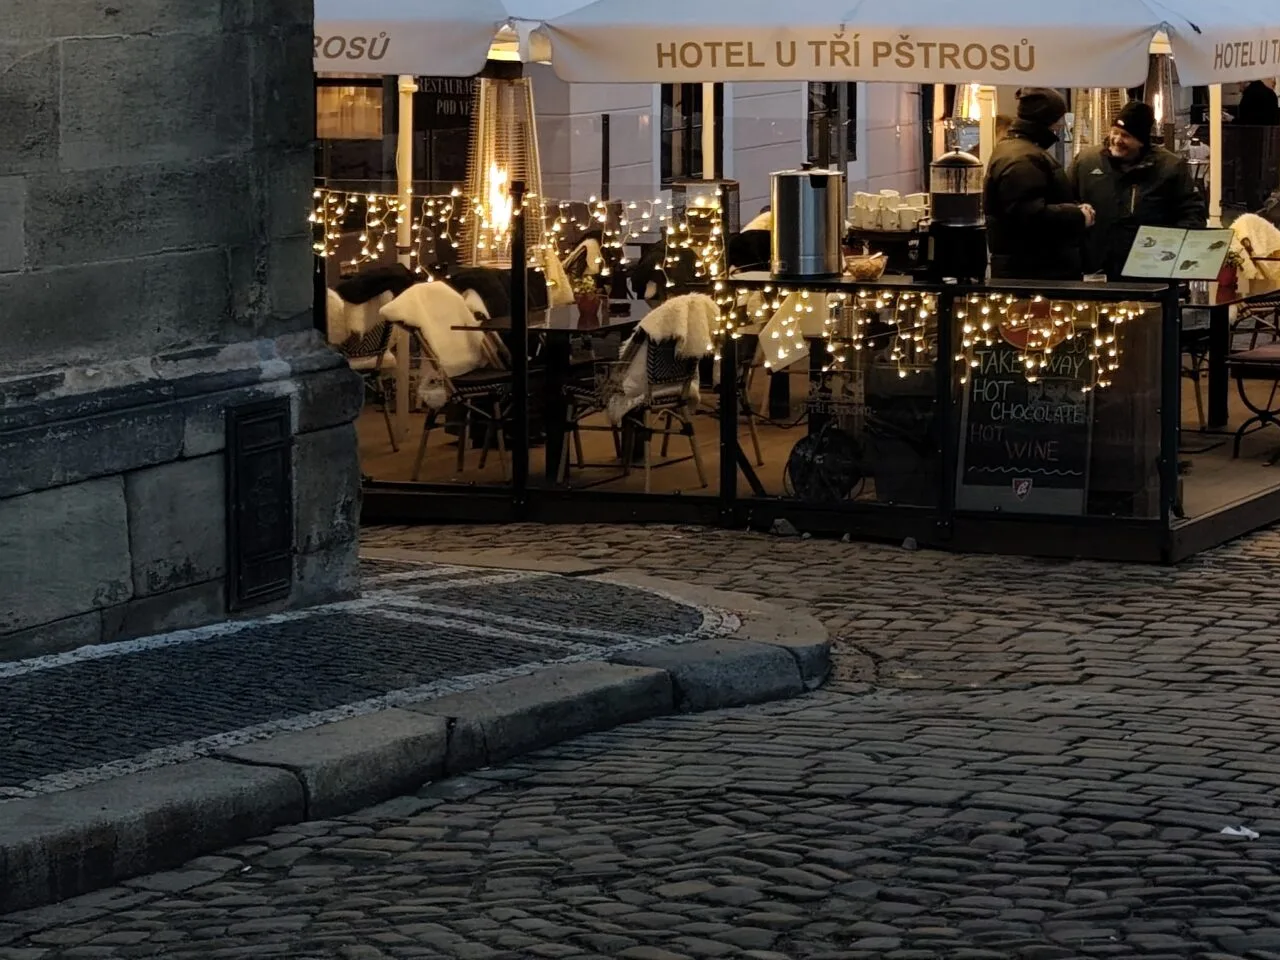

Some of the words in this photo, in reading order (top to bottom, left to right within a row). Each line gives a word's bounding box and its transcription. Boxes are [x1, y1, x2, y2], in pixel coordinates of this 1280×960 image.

[656, 41, 765, 69] HOTEL
[776, 41, 796, 67] U
[808, 33, 860, 68] TŘÍ
[872, 34, 1036, 72] PŠTROSŮ
[1213, 41, 1256, 70] HOTEL
[1259, 41, 1268, 65] U
[436, 99, 457, 116] POD
[975, 350, 1022, 375] TAKE
[973, 380, 1015, 403] HOT
[990, 401, 1085, 424] CHOCOLATE
[970, 422, 1006, 441] HOT
[1005, 440, 1060, 462] WINE
